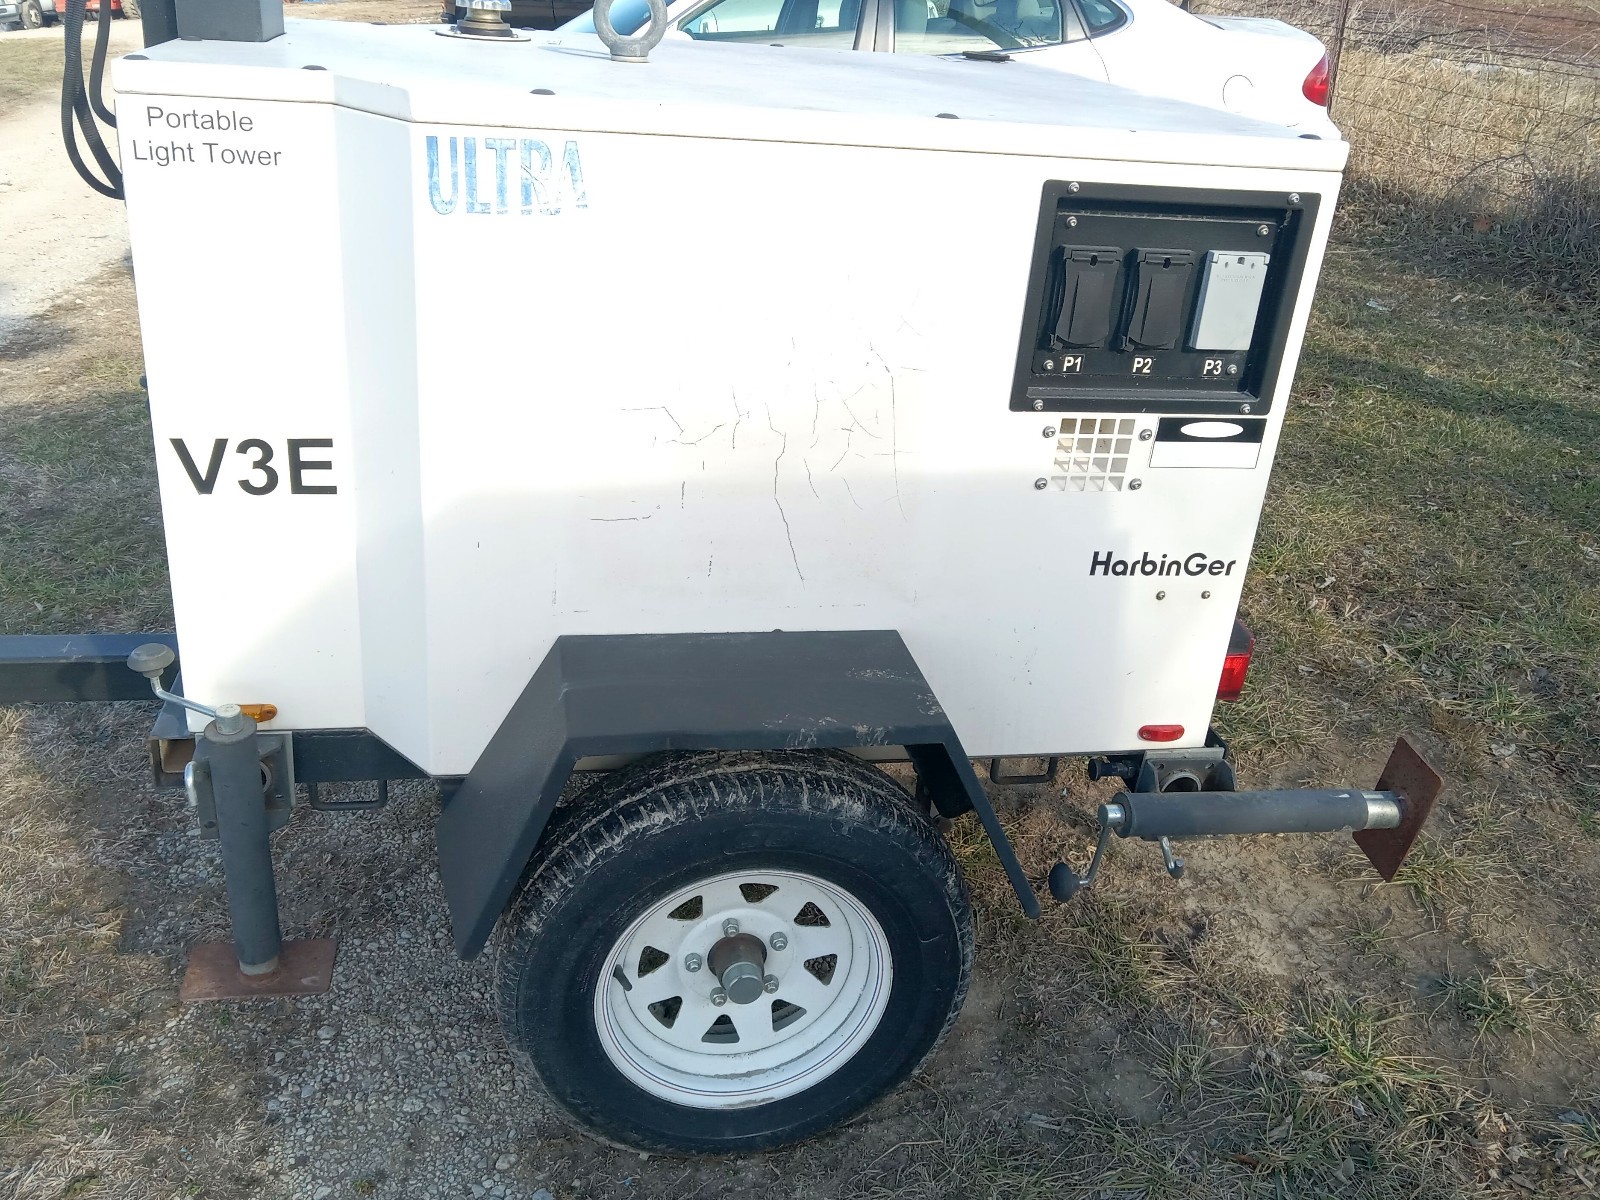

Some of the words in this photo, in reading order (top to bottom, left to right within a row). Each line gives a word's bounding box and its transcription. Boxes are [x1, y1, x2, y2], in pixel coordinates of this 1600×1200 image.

[147, 106, 254, 132] Portable
[132, 139, 196, 167] Light
[202, 142, 282, 166] Tower
[426, 136, 588, 216] ULTRA
[1062, 356, 1082, 372] P1
[1132, 357, 1153, 374] P2
[1203, 359, 1223, 376] P3
[169, 438, 337, 496] V3E
[1089, 551, 1236, 576] HarbinGer
